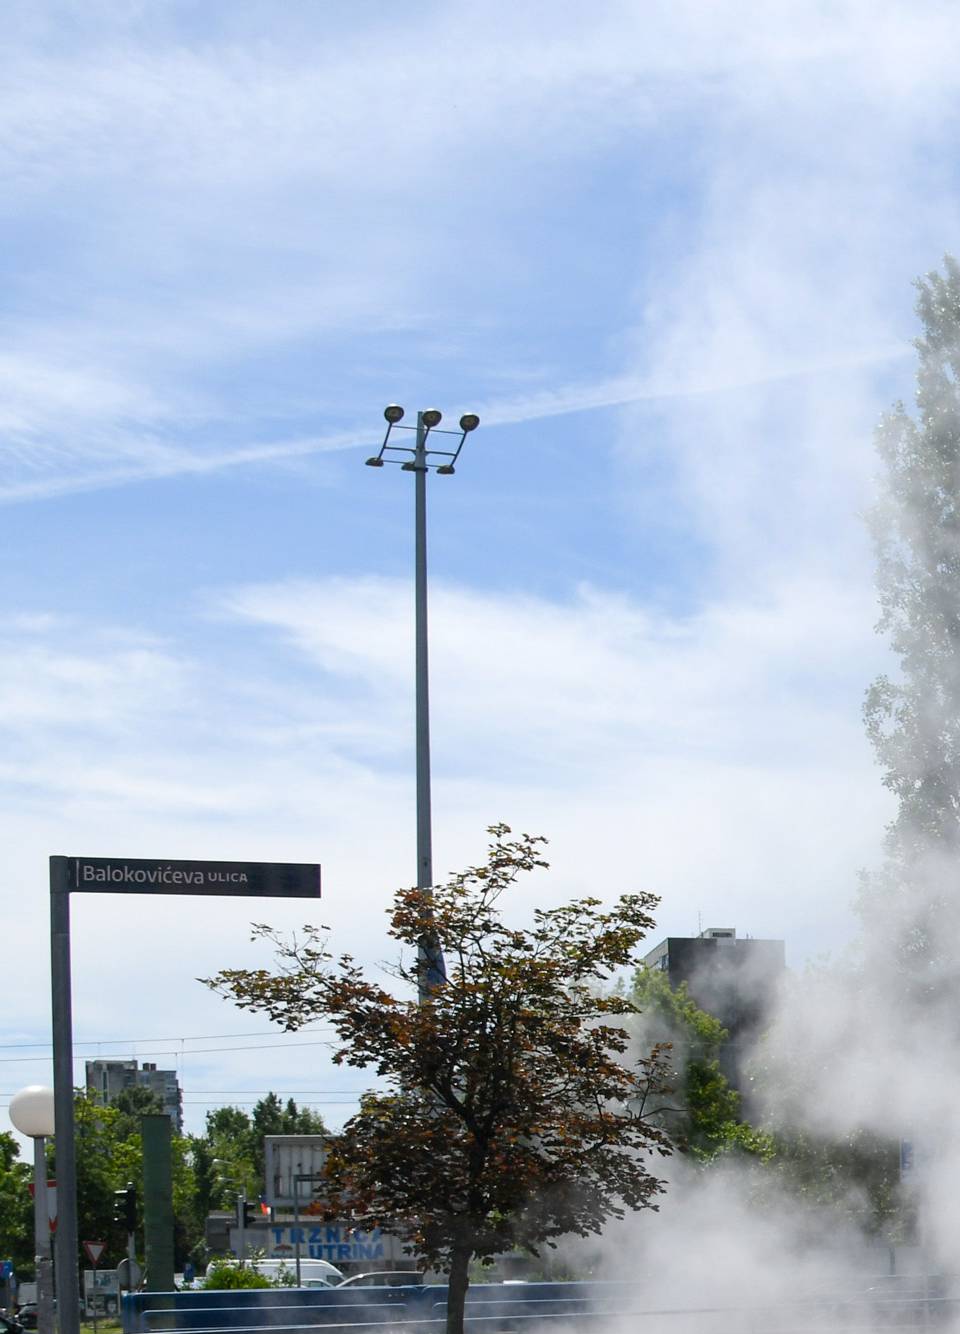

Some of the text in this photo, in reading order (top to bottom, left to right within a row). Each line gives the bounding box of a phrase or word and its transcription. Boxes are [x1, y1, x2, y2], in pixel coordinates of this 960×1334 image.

[83, 865, 249, 885] Balokovićeva ULICA
[308, 1243, 384, 1260] UTRINA
